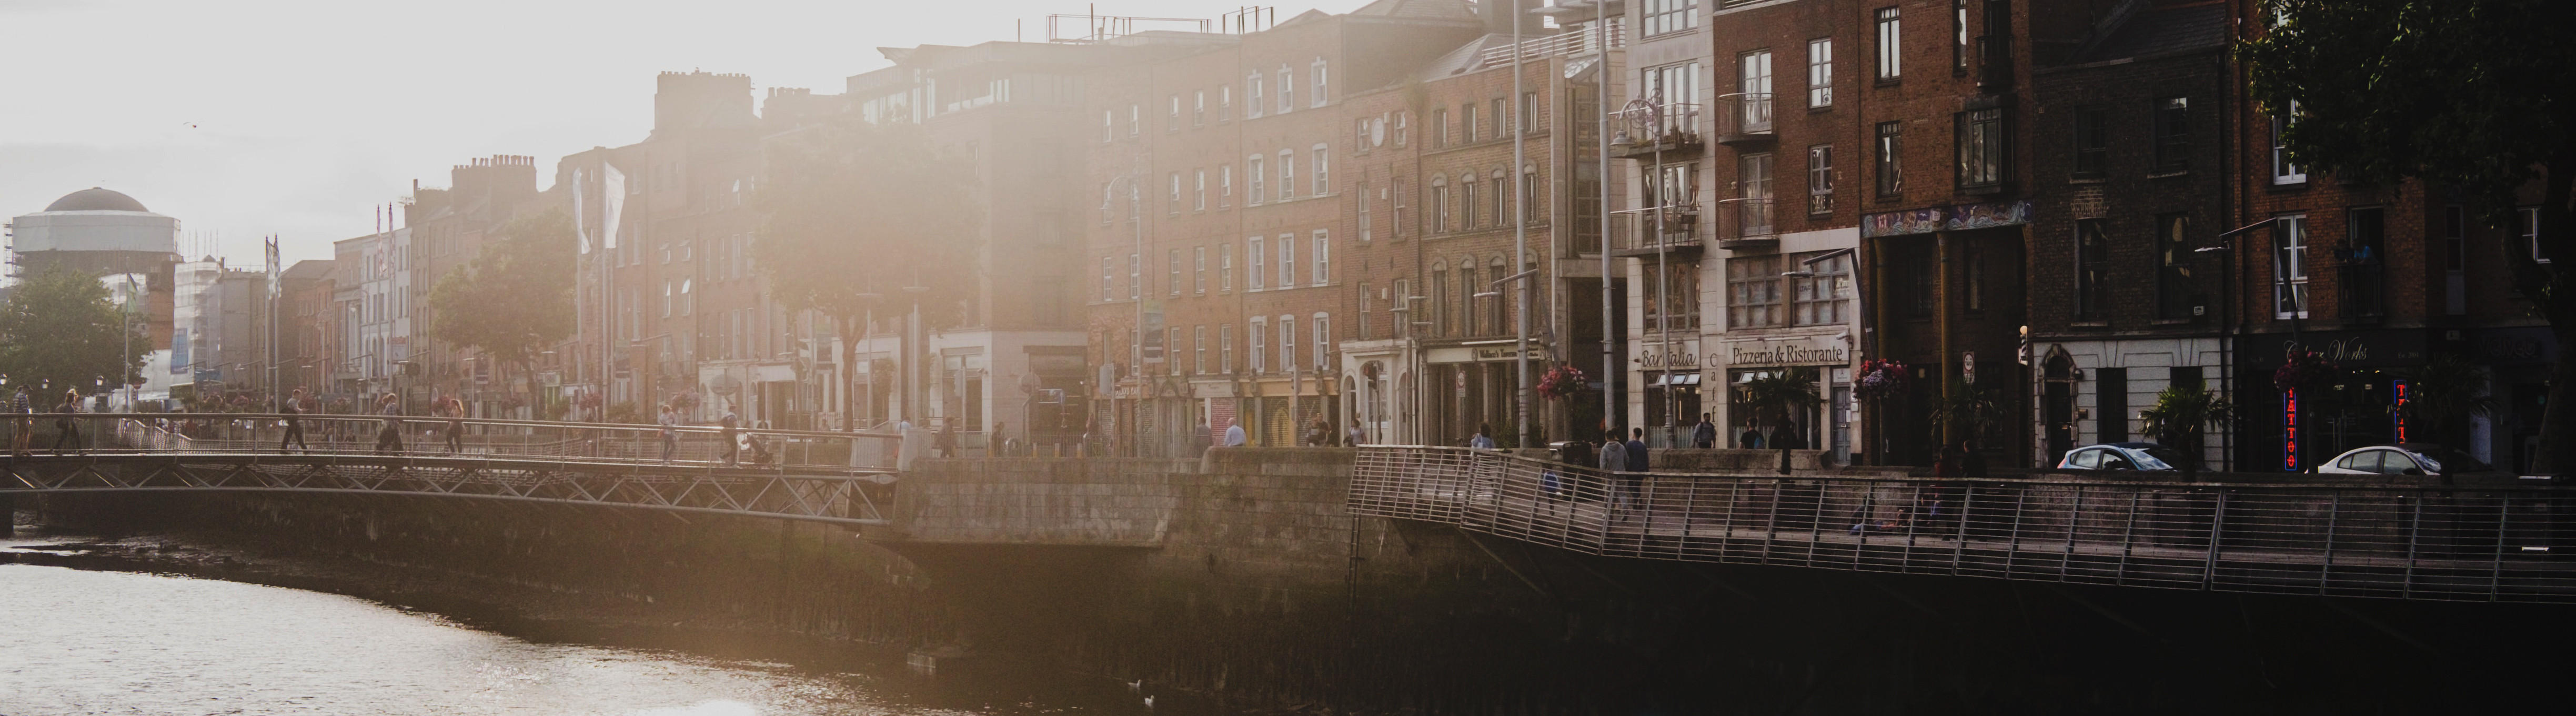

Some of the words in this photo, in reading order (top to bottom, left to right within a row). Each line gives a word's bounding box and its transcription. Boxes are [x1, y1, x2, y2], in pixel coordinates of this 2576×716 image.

[1733, 347, 1773, 365] Pizzeria
[1775, 345, 1784, 363] &
[1787, 345, 1843, 363] Ristorante
[2328, 336, 2367, 362] Works
